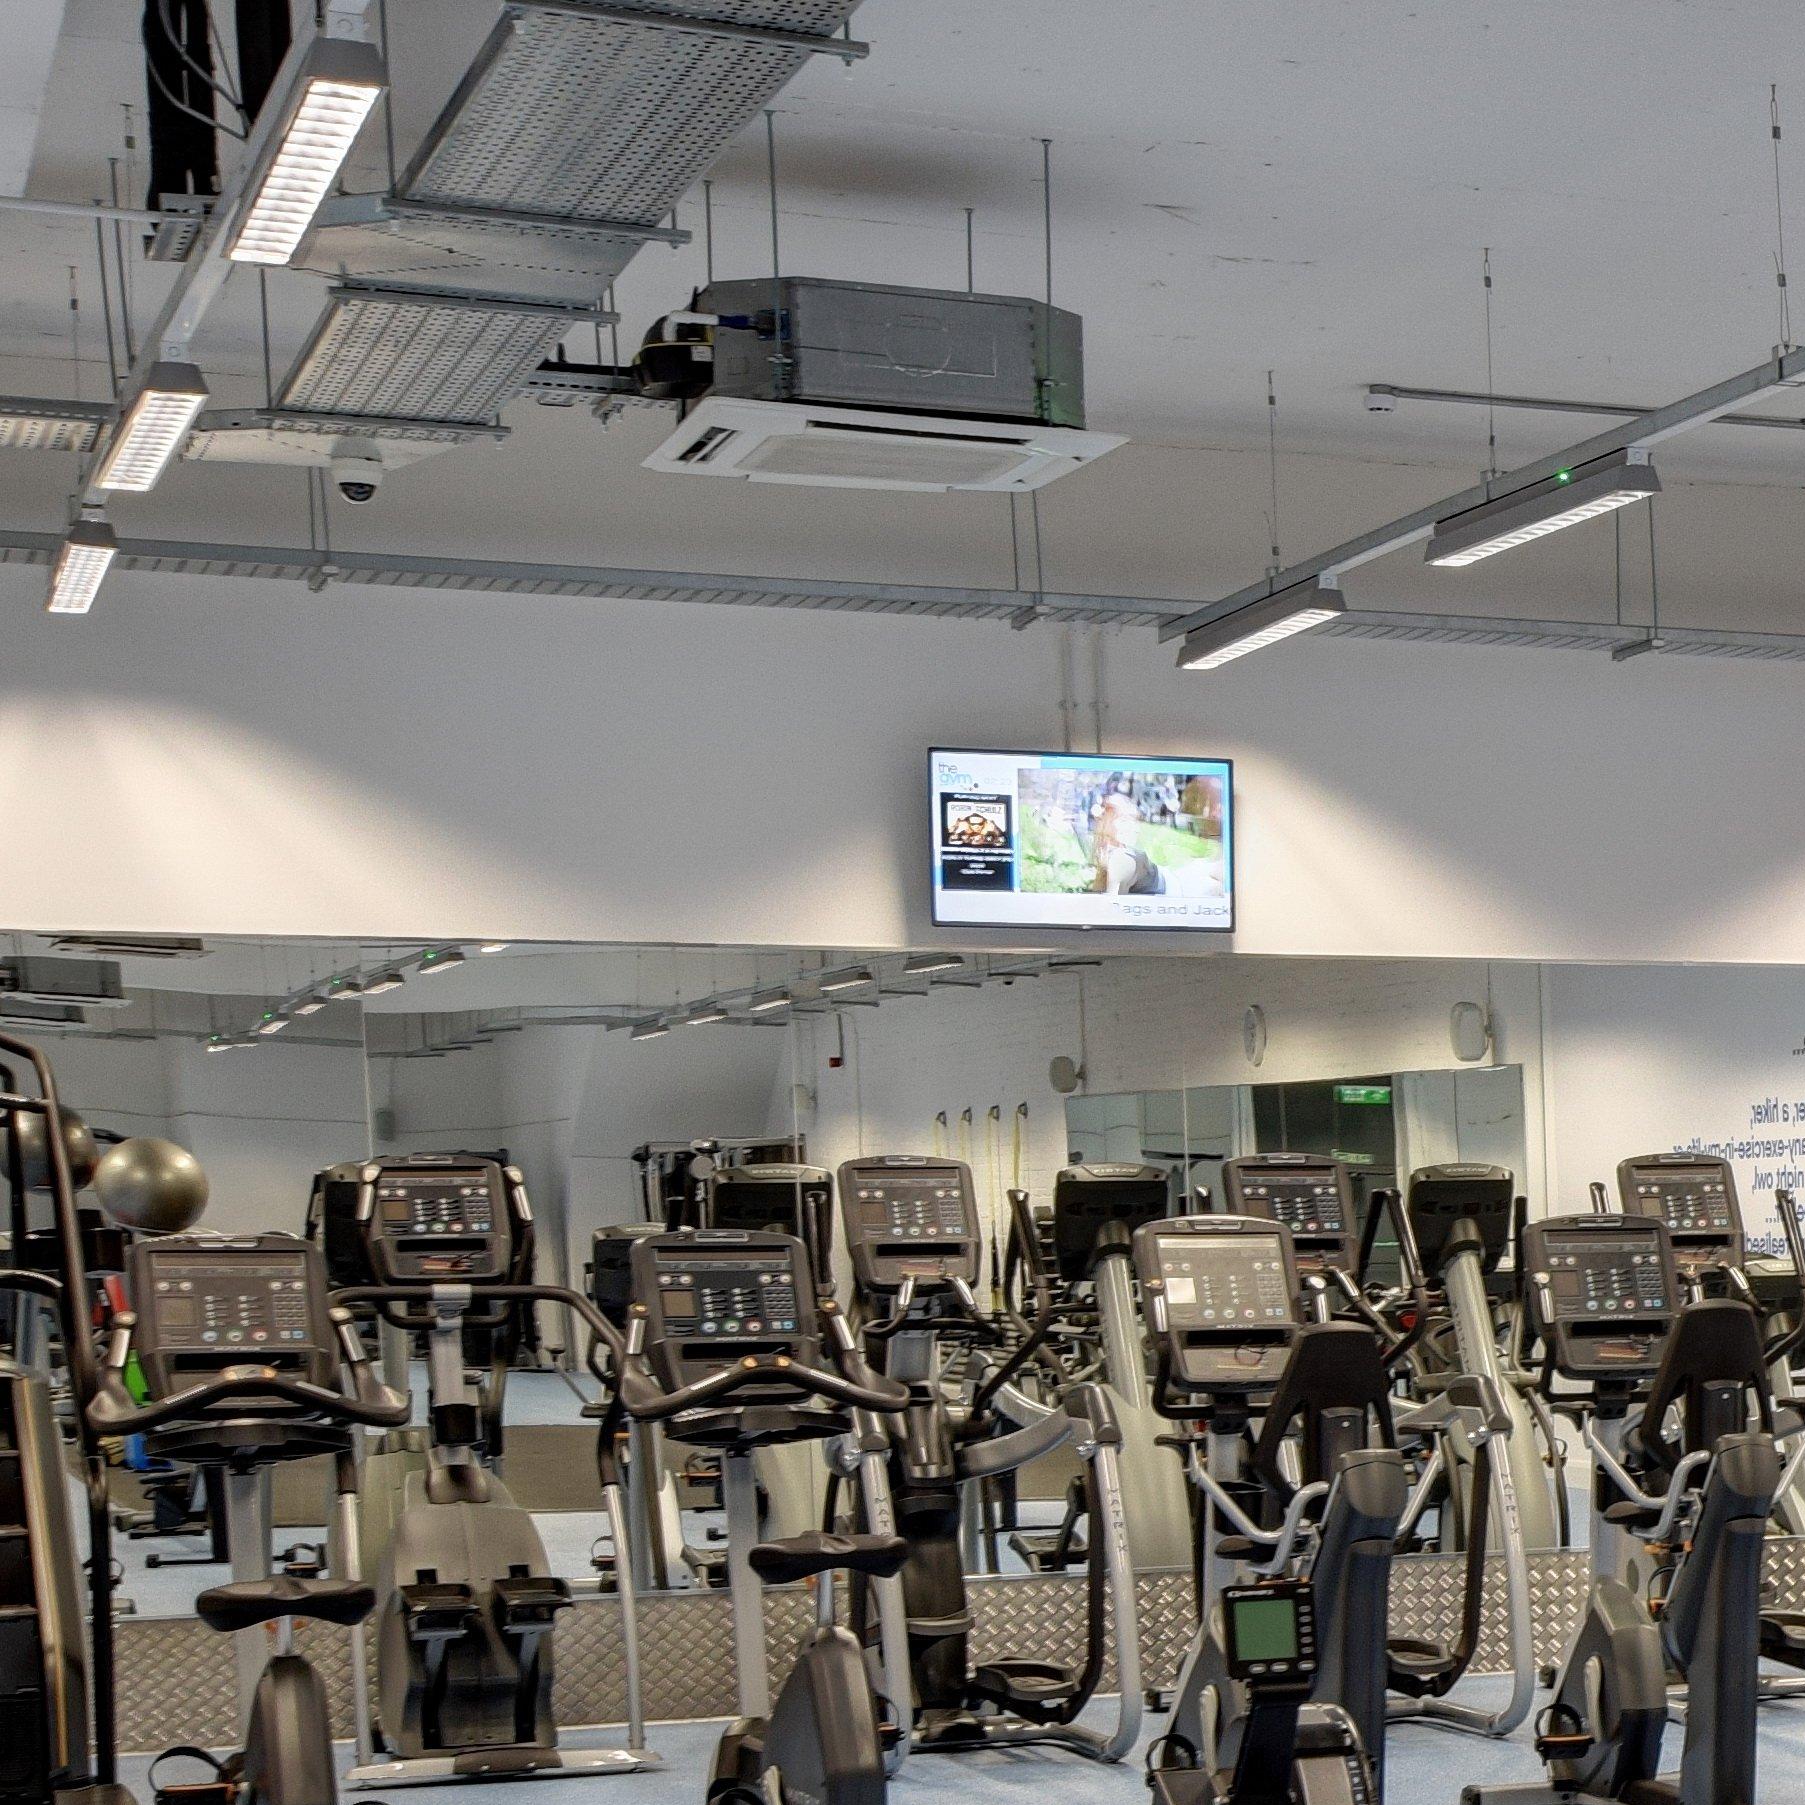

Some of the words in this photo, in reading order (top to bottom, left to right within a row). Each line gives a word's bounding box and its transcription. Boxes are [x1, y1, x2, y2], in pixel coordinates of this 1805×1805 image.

[938, 761, 958, 774] the
[939, 773, 973, 787] gym
[1113, 902, 1152, 917] ags
[1157, 904, 1189, 915] and
